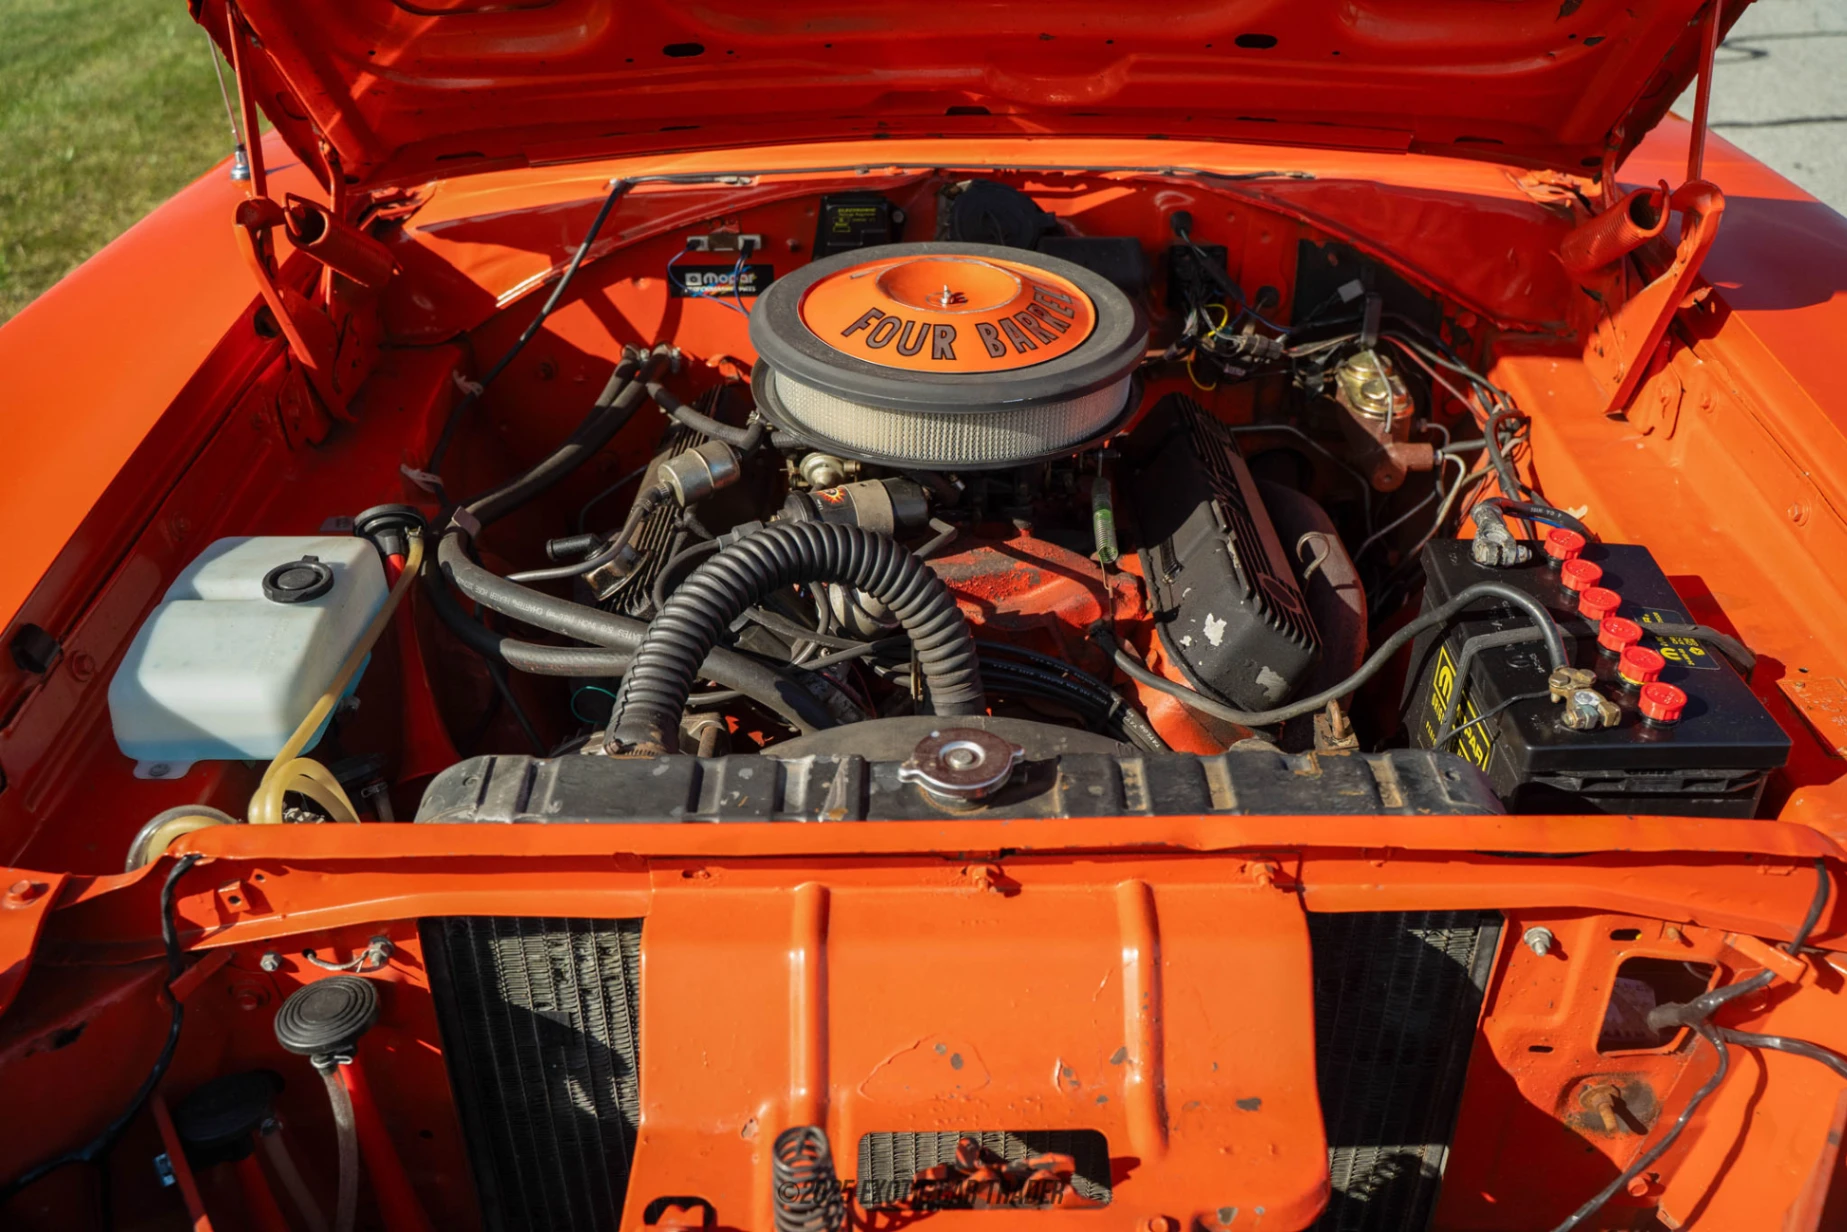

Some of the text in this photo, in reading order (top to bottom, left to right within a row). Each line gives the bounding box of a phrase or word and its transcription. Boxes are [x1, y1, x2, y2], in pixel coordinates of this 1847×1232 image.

[841, 286, 1076, 361] FOUR BARREL
[1139, 724, 1160, 748] TAYLOR
